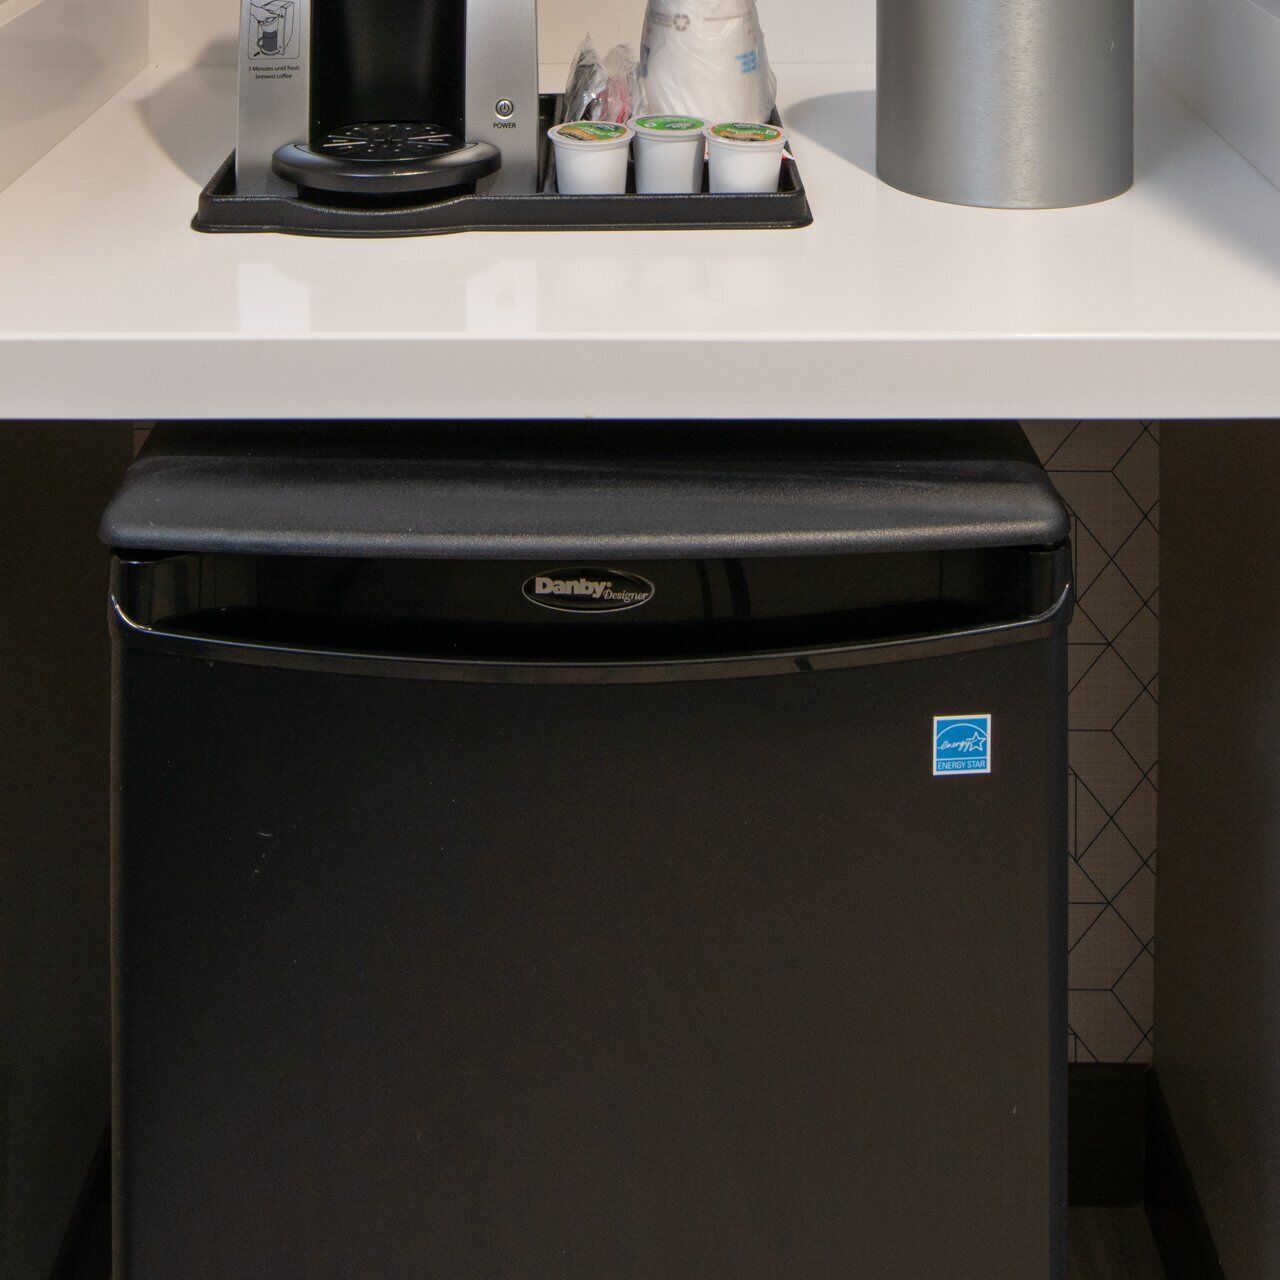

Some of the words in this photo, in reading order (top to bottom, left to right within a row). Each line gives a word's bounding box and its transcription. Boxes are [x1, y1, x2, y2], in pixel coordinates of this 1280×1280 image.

[535, 577, 607, 599] Danby
[602, 588, 650, 602] Designer
[937, 761, 966, 770] ENERGY
[967, 760, 986, 768] STAR
